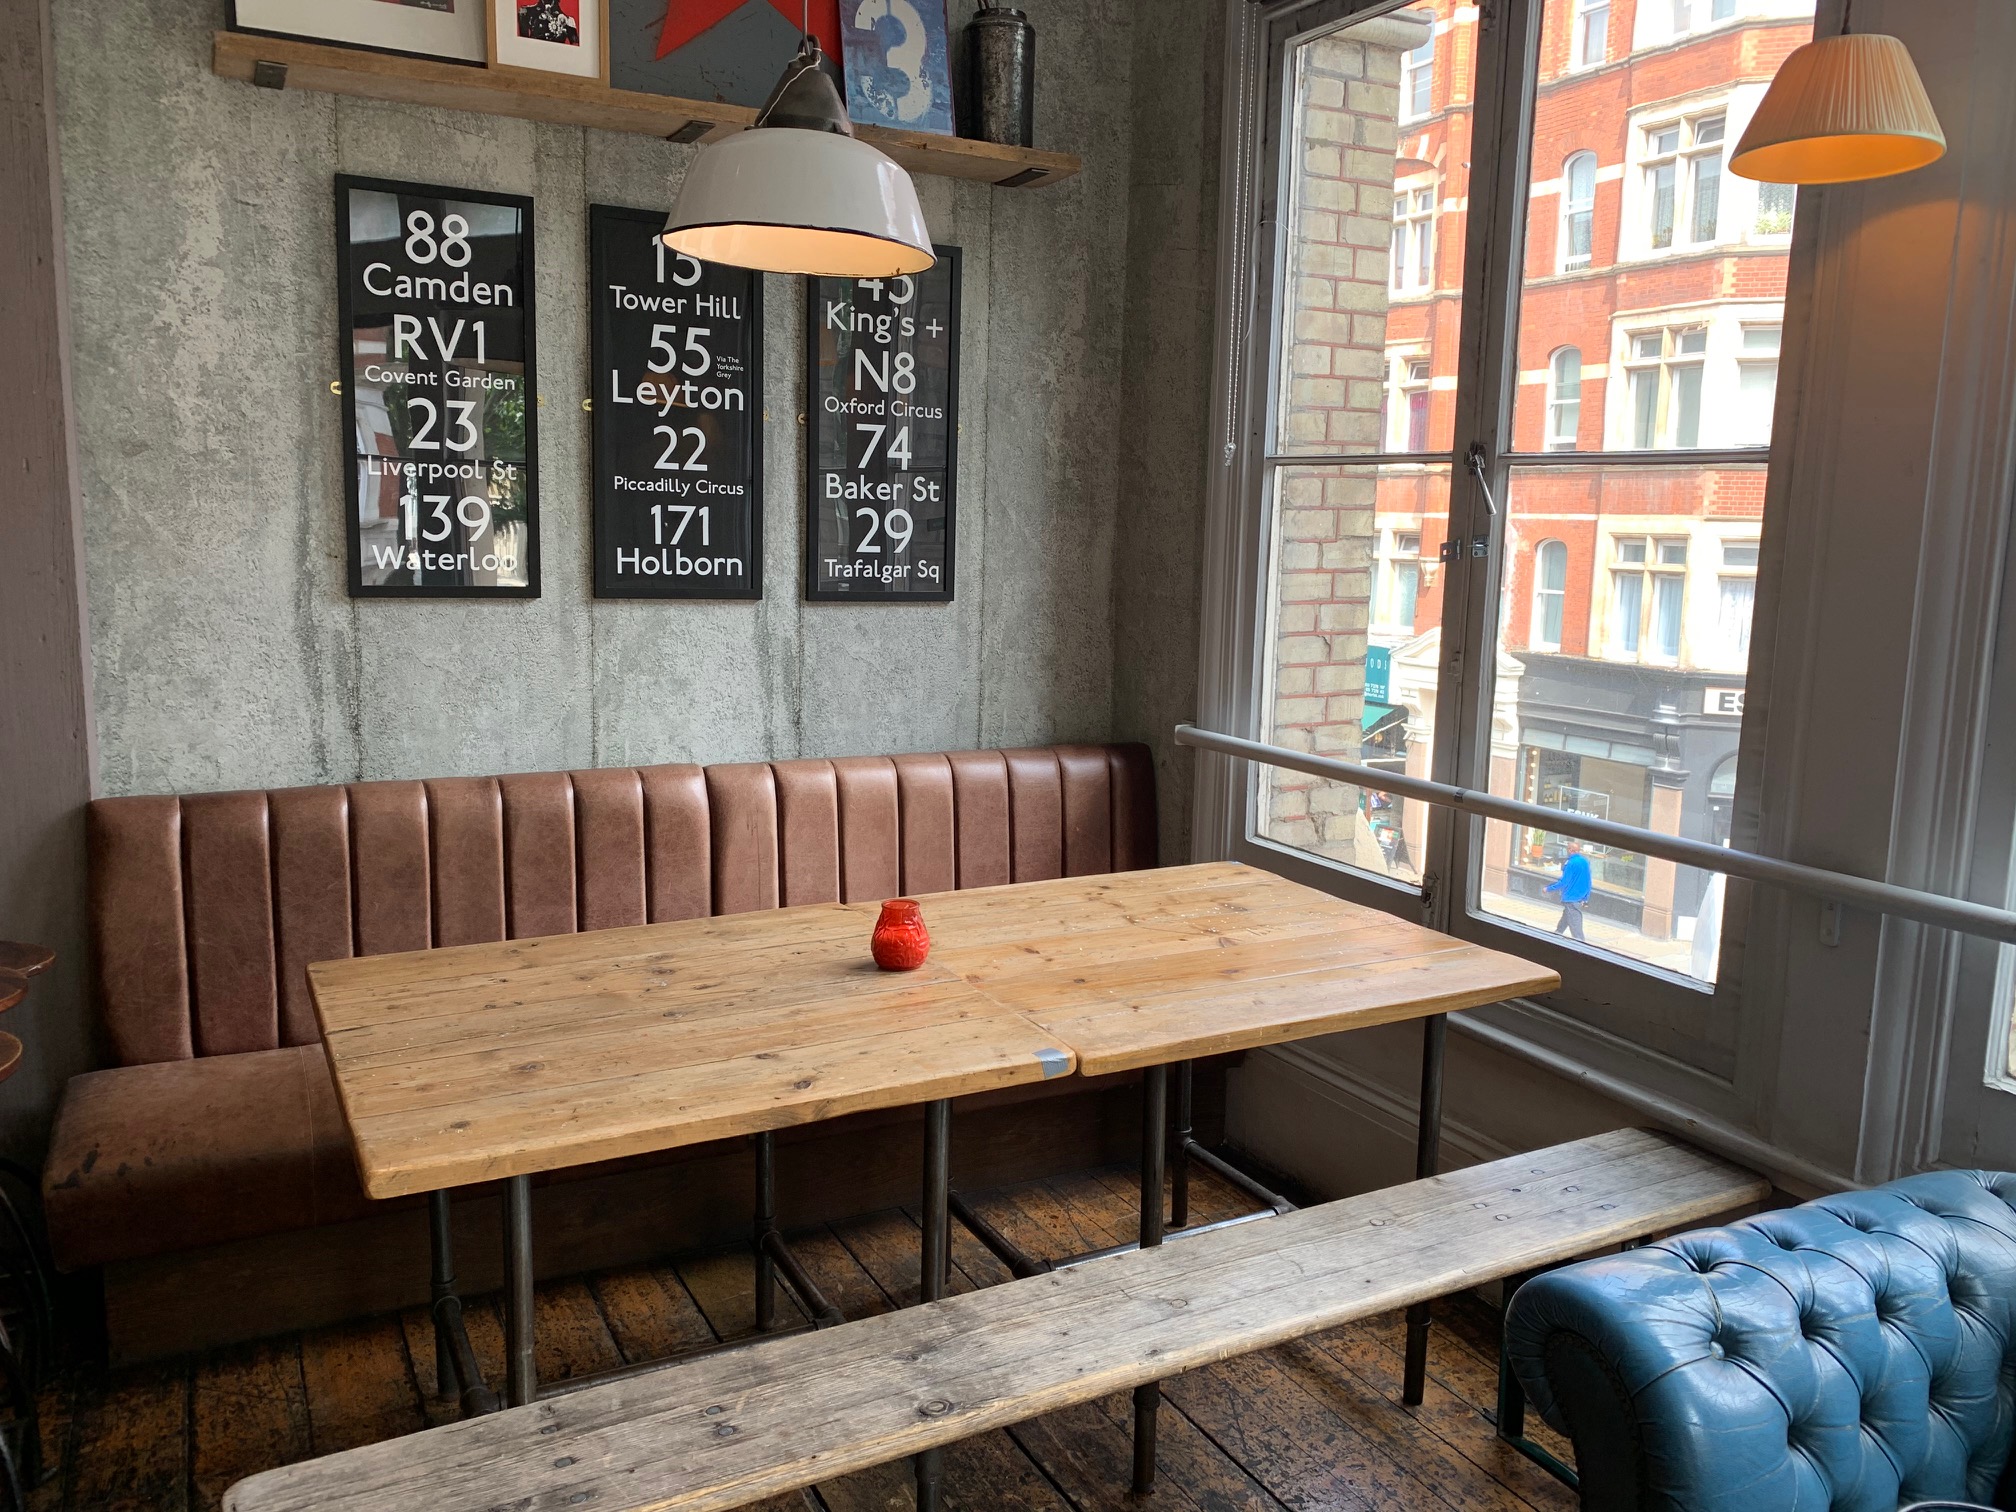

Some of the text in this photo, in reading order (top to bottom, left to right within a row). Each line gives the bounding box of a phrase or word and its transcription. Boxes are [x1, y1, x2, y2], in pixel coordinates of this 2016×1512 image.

[405, 210, 472, 268] 88
[652, 233, 702, 287] 15
[362, 262, 513, 307] Camden
[609, 285, 741, 320] Tower Hill
[393, 313, 485, 364] RV1
[826, 301, 915, 344] King's
[647, 323, 712, 377] 55
[716, 355, 740, 364] Via The
[716, 363, 744, 372] Yorkshire
[364, 365, 516, 391] Covent Garden
[716, 371, 732, 380] Grey
[854, 348, 917, 395] N8
[612, 369, 744, 417] Leyton
[824, 396, 943, 420] Oxford Circus
[407, 397, 478, 452] 23
[653, 425, 708, 472] 22
[855, 423, 912, 471] 74
[367, 454, 517, 484] Liverpool St
[614, 476, 744, 497] Piccadilly Circus
[825, 473, 940, 503] Baker St
[399, 494, 491, 542] 139
[650, 504, 710, 546] 171
[855, 507, 914, 554] 29
[372, 545, 518, 572] Waterloo
[616, 547, 743, 577] Holborn
[824, 558, 940, 584] Trafalgar Sq
